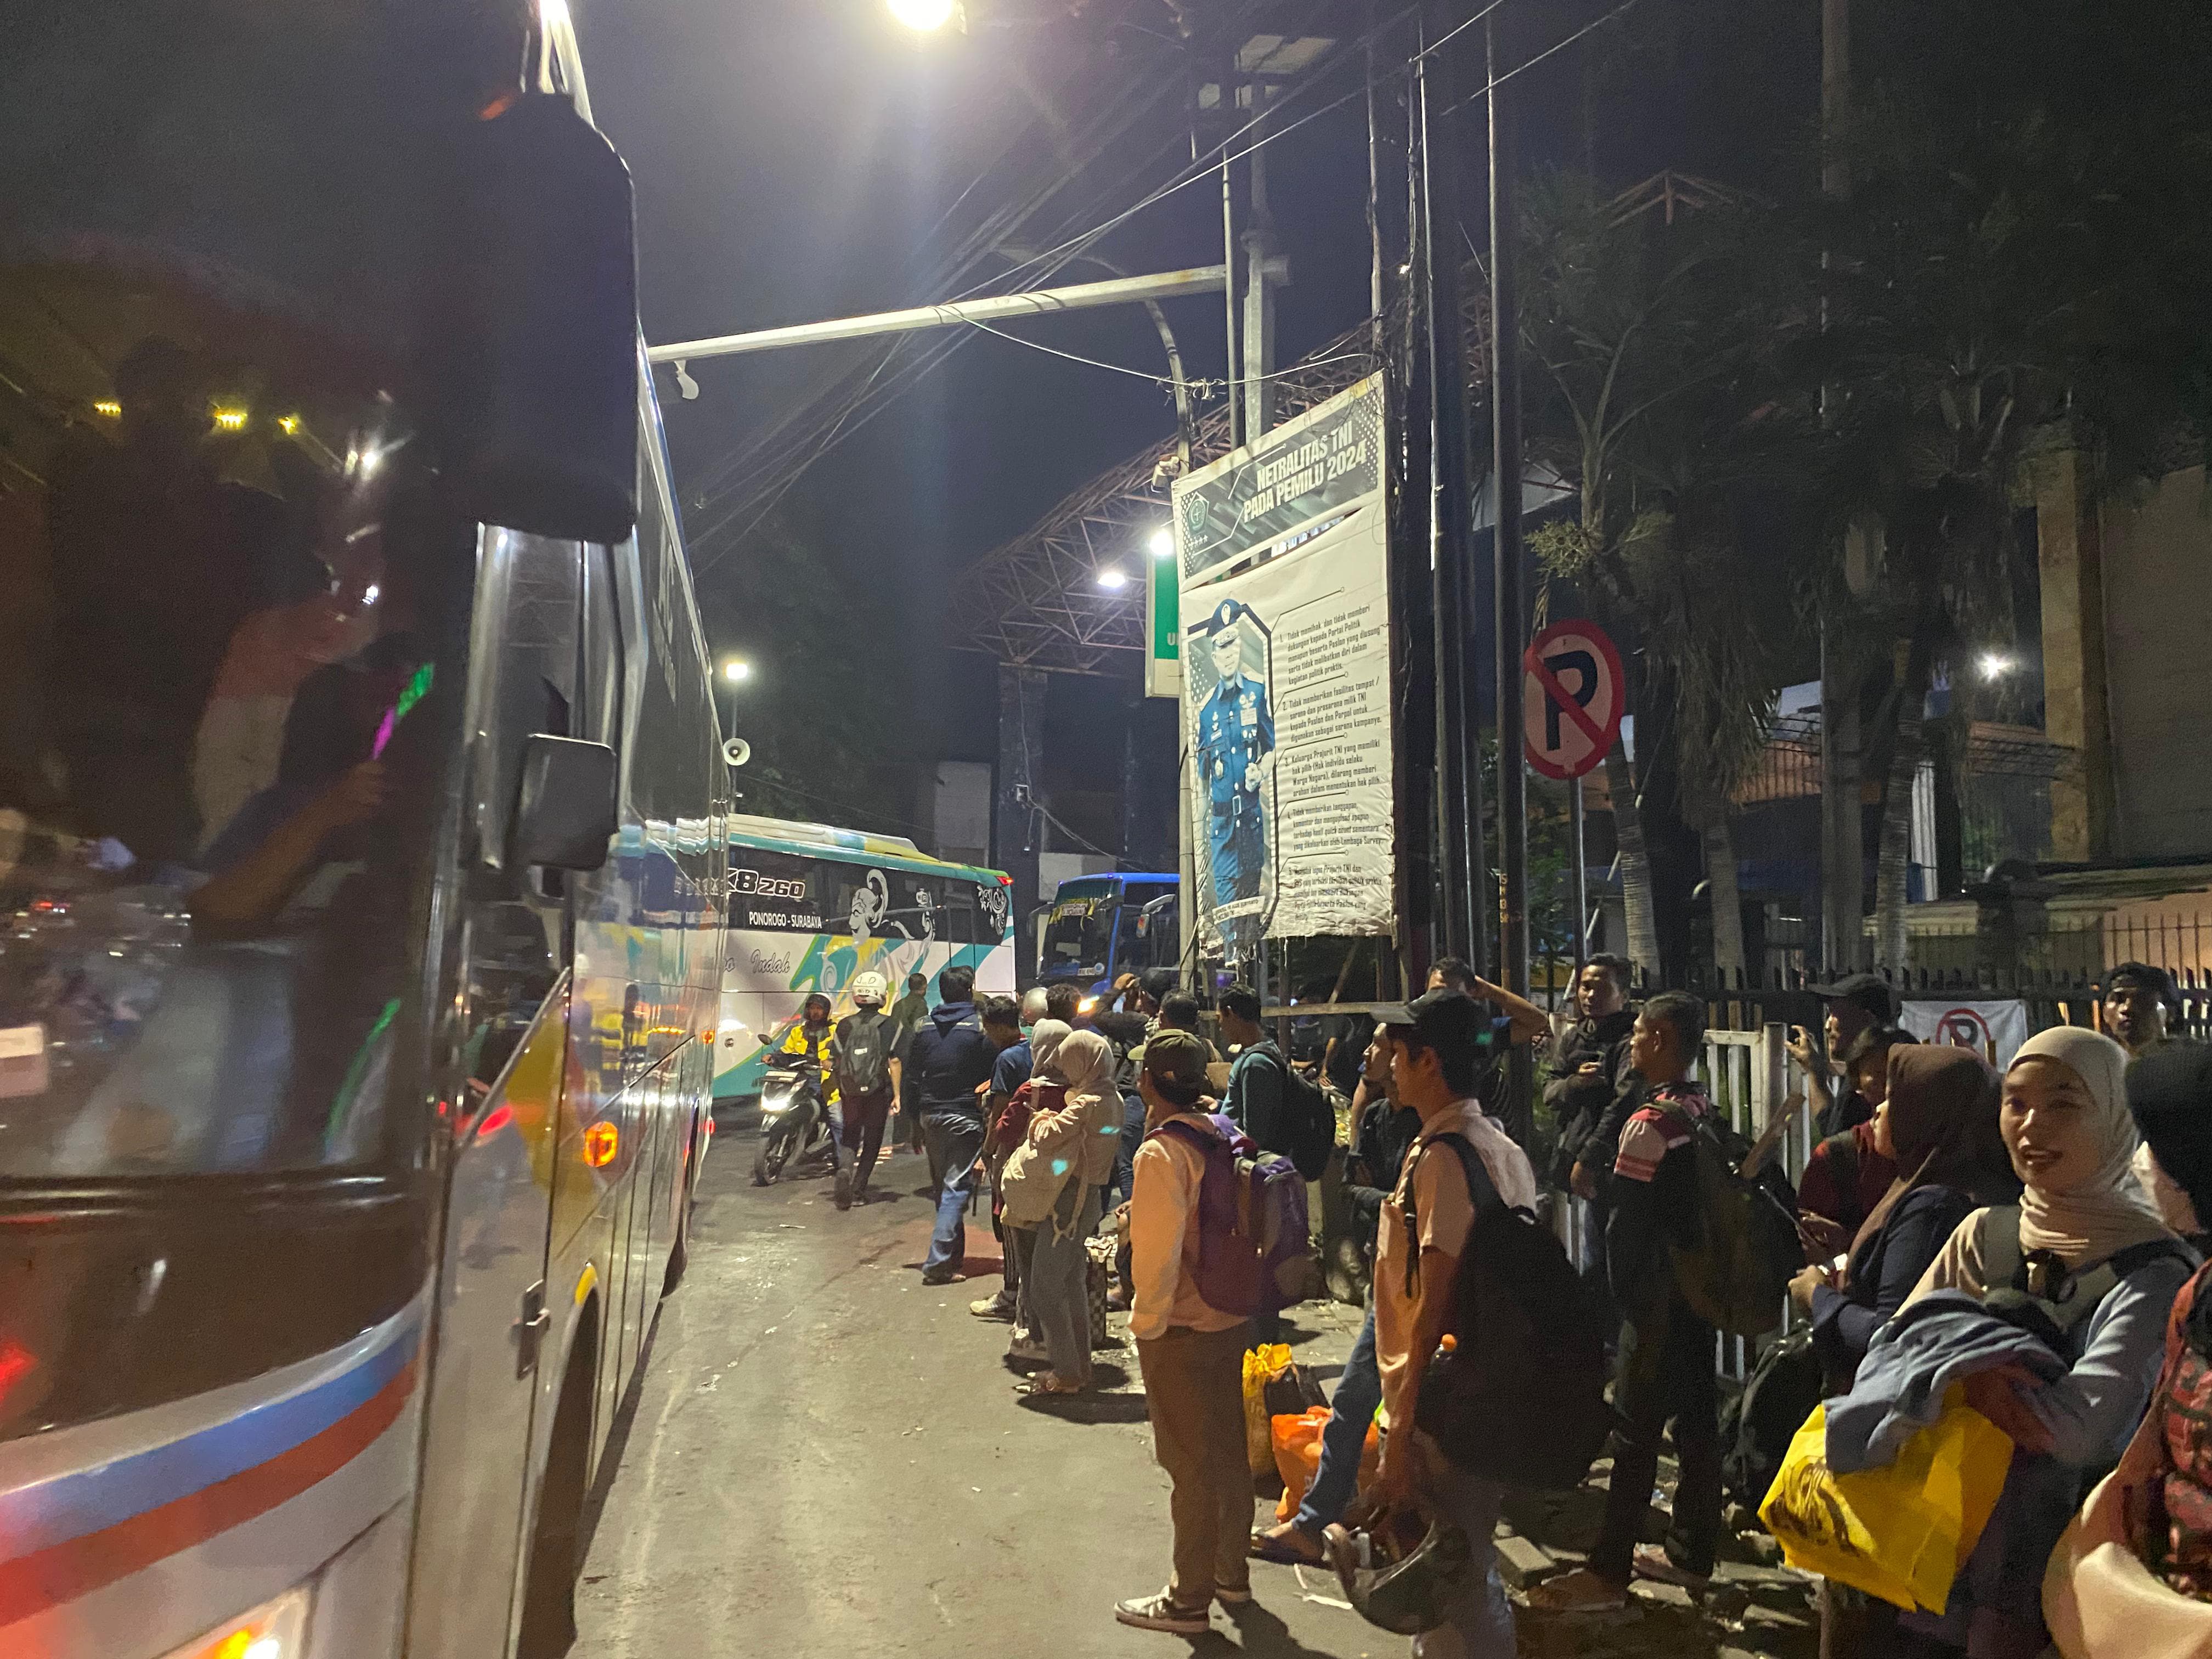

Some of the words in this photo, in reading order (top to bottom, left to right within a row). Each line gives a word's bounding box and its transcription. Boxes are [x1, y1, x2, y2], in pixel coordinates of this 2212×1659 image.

[1257, 435, 1328, 492] NETRALITAS
[1330, 420, 1352, 453] TNI
[1243, 488, 1274, 523] PADA
[1276, 461, 1324, 507] PEMILU
[1327, 438, 1368, 481] 2024
[1288, 629, 1300, 640] Tidak
[1324, 618, 1332, 627] dan
[1334, 612, 1346, 623] tidak
[1310, 631, 1327, 644] kepada
[1328, 624, 1344, 637] Partai
[1345, 618, 1360, 631] Politik
[1329, 638, 1345, 648] Paslon
[1346, 634, 1358, 645] yang
[1288, 664, 1301, 674] serta
[1302, 658, 1313, 669] tidak
[1341, 647, 1351, 656] diri
[1352, 643, 1367, 653] dalam
[1289, 698, 1301, 708] Tidak
[1307, 705, 1316, 714] dan
[1357, 691, 1366, 702] TNI
[1543, 650, 1598, 752] P
[1307, 716, 1324, 726] Paslon
[1325, 713, 1334, 722] dan
[1335, 708, 1352, 719] Parpol
[1315, 724, 1334, 736] sebagai
[1335, 722, 1352, 731] sarana
[1292, 754, 1312, 763] Keluarga
[1313, 748, 1333, 759] Prajurit
[1334, 745, 1342, 754] TNI
[1344, 745, 1356, 754] yang
[757, 877, 805, 899] 260
[749, 911, 787, 927] PONOROGO
[791, 915, 822, 929] SURABAYA
[751, 949, 791, 973] Indah
